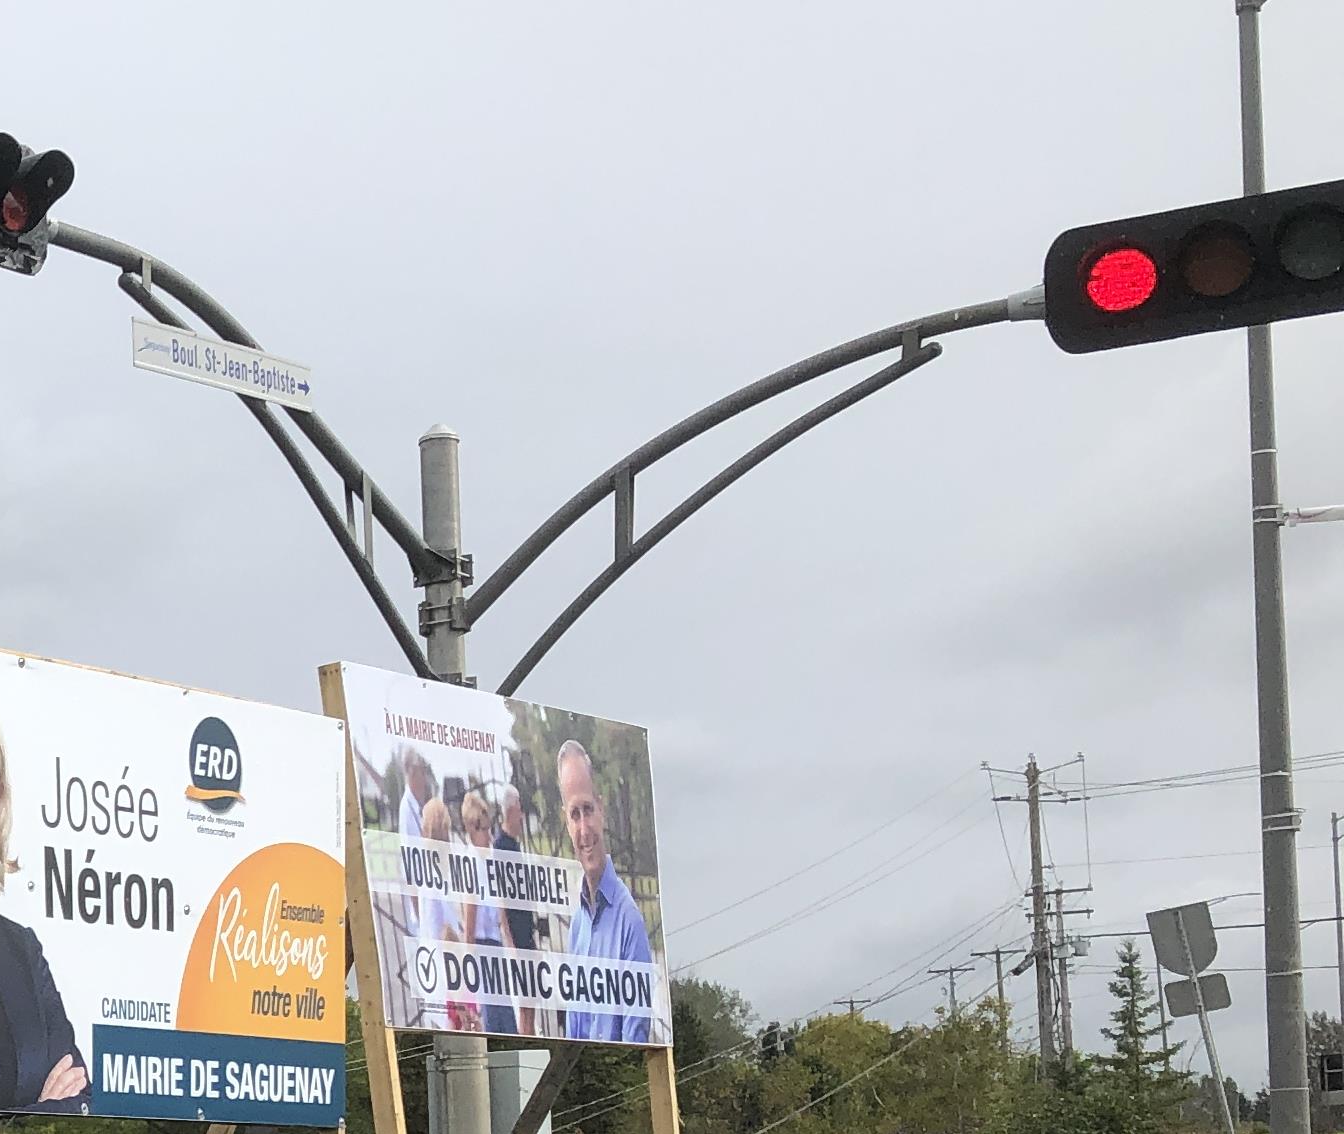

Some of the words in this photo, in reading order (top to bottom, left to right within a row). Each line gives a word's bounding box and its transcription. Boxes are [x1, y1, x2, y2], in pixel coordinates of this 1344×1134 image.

[171, 339, 201, 369] Boul.
[205, 347, 295, 395] St-Jean-Baptiste
[393, 714, 405, 737] LA
[405, 716, 437, 744] MAIRIE
[436, 723, 450, 746] DE
[450, 725, 496, 754] SAGUENAY
[194, 743, 238, 781] ERD
[41, 757, 159, 842] Josée
[44, 846, 175, 932] Néron
[401, 845, 448, 895] VOUS,
[448, 853, 485, 900] MOI,
[486, 859, 570, 906] ENSEMBLE!
[209, 882, 329, 983] Réalisons
[281, 900, 325, 924] Ensemble
[251, 986, 291, 1017] notre
[296, 987, 325, 1021] ville
[443, 951, 552, 999] DOMINIC
[558, 963, 652, 1008] GAGNON
[102, 997, 171, 1023] CANDIDATE
[102, 1053, 184, 1097] MAIRIE
[190, 1059, 220, 1099] DE
[225, 1061, 335, 1105] SAGUENAY
